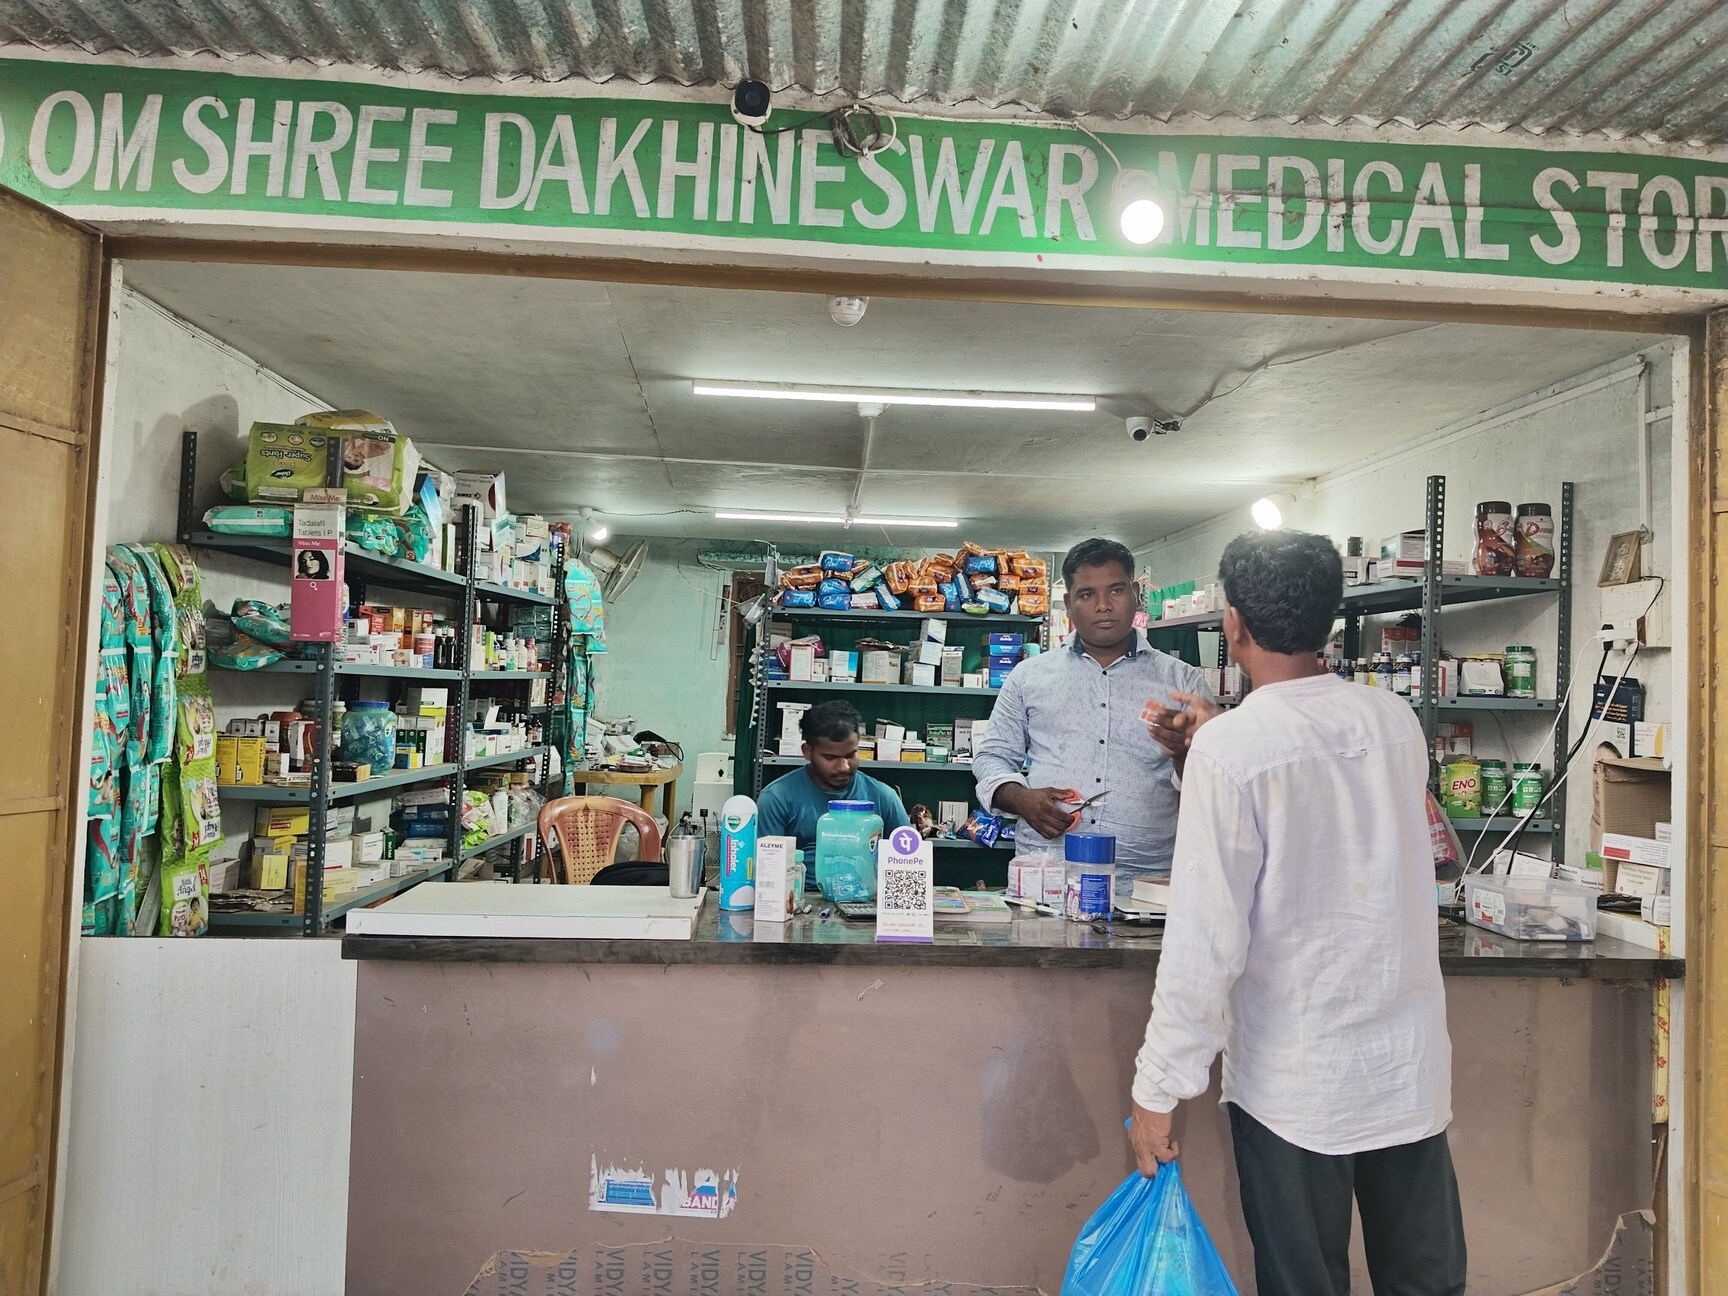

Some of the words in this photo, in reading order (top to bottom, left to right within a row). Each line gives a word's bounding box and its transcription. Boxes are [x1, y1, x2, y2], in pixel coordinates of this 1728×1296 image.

[28, 89, 163, 191] OM
[172, 96, 458, 208] SHREE
[480, 112, 1098, 242] DAKHINESWAR
[1156, 150, 1509, 261] MEDICAL
[1530, 167, 1728, 273] STOR
[310, 494, 327, 502] Miss
[328, 494, 340, 502] Me
[298, 519, 326, 527] Tadalafil
[298, 529, 322, 537] Tablets
[1452, 778, 1477, 791] ENO
[731, 839, 741, 873] Inhaler
[887, 856, 924, 866] PhonePe
[498, 1251, 509, 1296] LAMI
[594, 1250, 604, 1296] LAMI
[605, 1251, 625, 1296] VIDY
[653, 1250, 673, 1296] VIDY
[701, 1250, 720, 1296] VIDY
[748, 1250, 767, 1296] VIDY
[795, 1251, 814, 1296] VIDY
